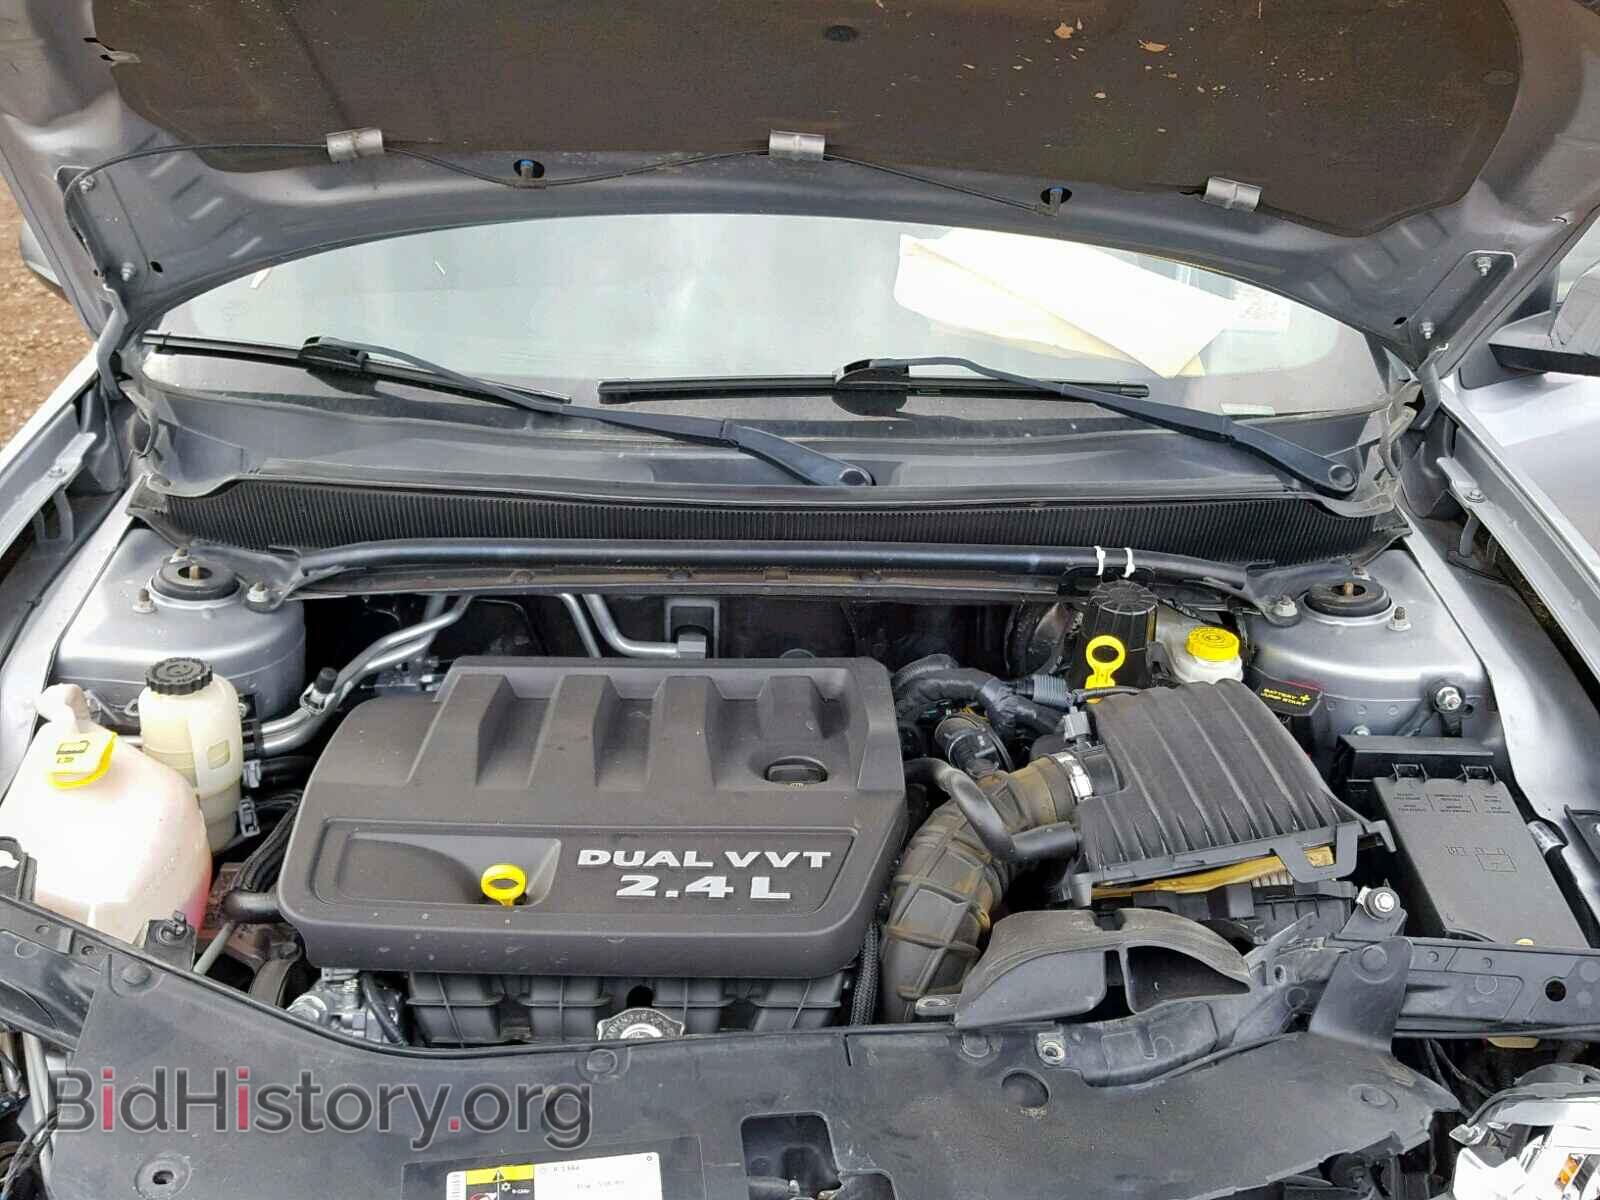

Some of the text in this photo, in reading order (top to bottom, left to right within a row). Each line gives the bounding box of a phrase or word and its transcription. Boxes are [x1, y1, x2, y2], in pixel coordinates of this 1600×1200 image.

[1263, 688, 1298, 700] BATTERY
[577, 849, 832, 868] DUAL VVT
[616, 875, 792, 900] 2.4 L
